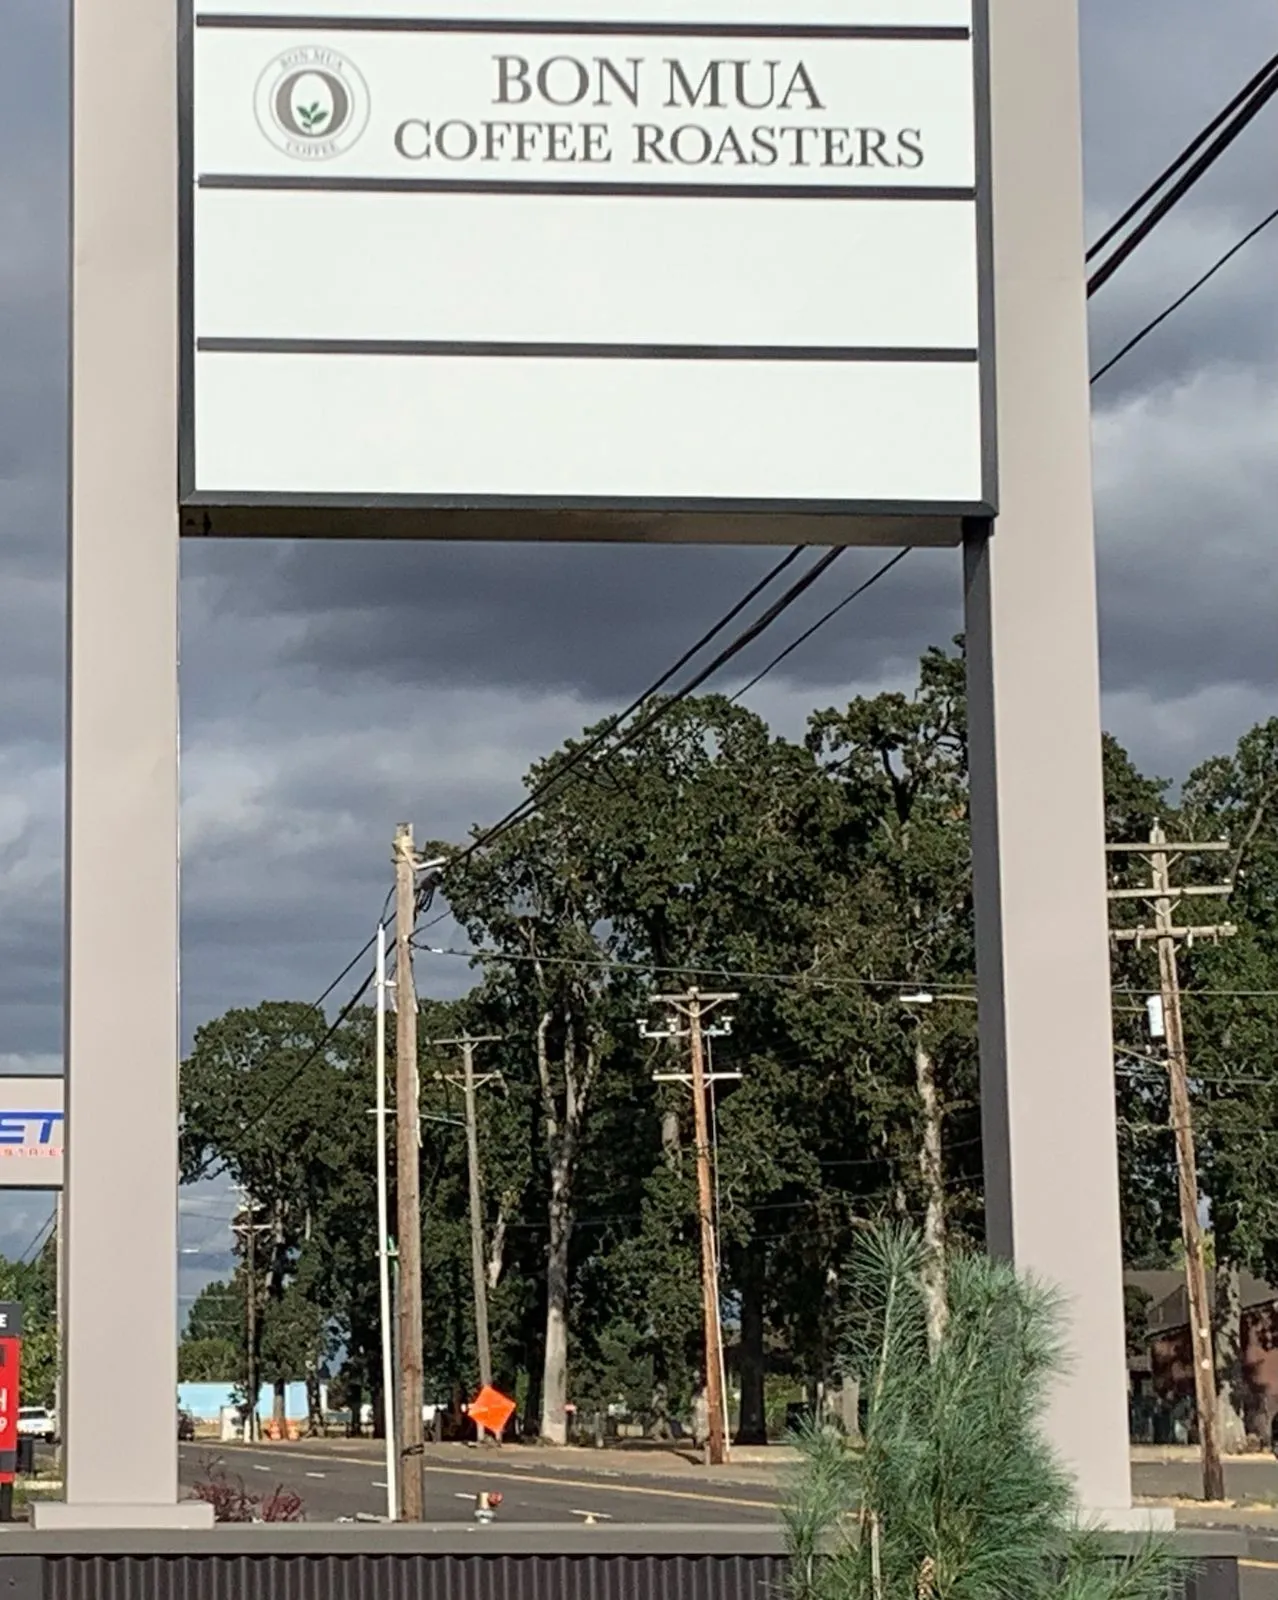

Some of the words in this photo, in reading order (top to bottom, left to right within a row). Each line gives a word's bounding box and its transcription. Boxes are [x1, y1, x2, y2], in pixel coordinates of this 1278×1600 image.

[491, 55, 645, 108] BON
[662, 57, 827, 110] MUA
[393, 118, 613, 163] COFFEE
[632, 122, 925, 169] ROASTERS
